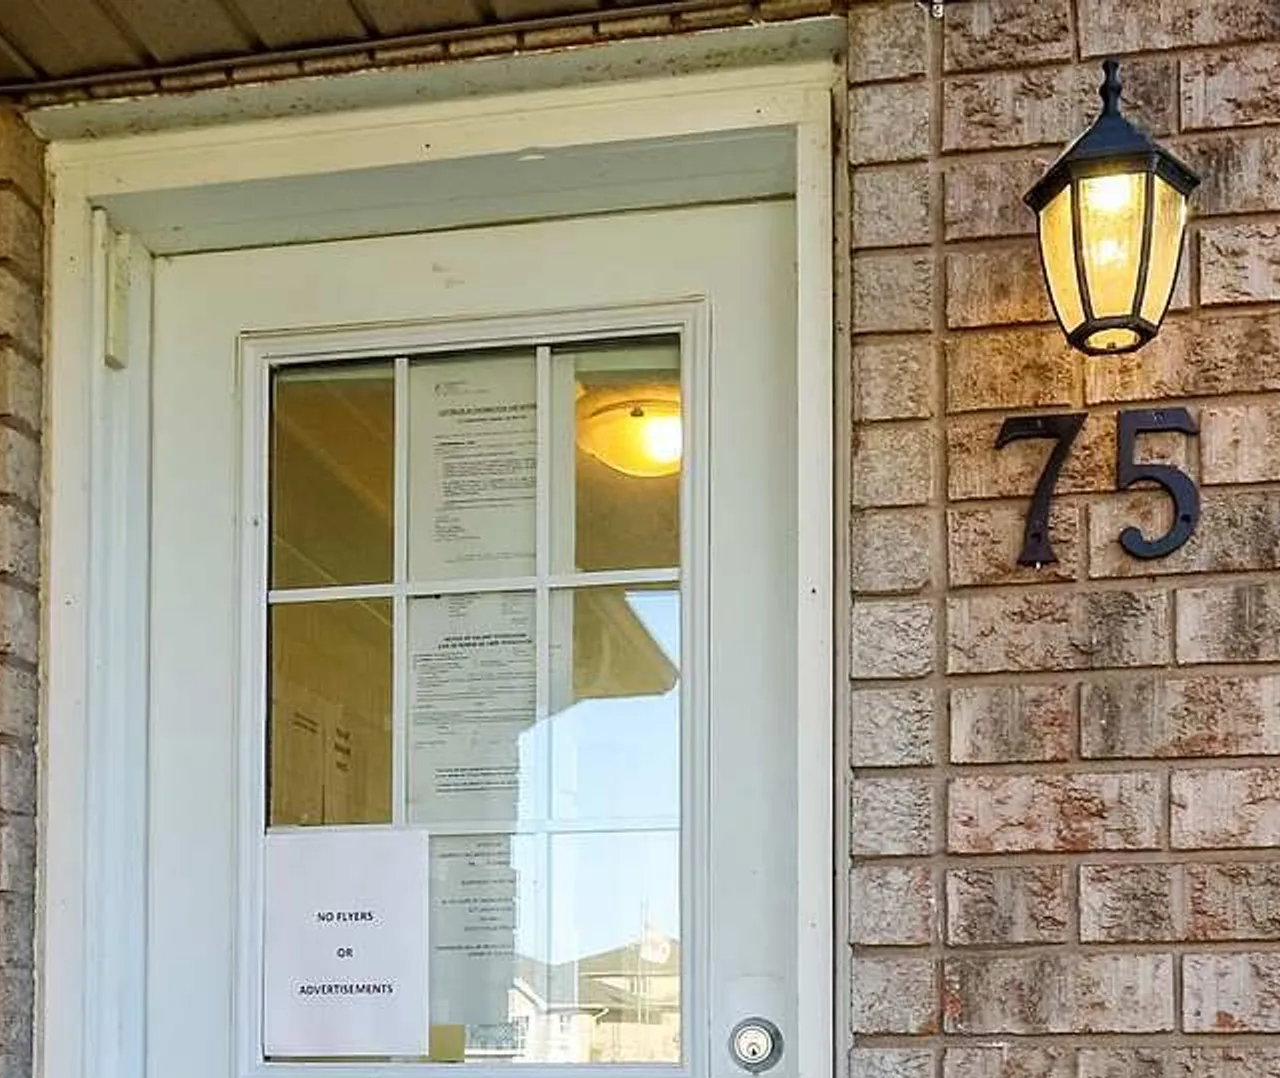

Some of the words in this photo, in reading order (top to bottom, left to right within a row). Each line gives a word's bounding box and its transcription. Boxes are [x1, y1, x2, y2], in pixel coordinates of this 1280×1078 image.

[994, 407, 1201, 568] 75
[317, 911, 334, 922] NO
[336, 911, 373, 922] FLYERS
[336, 947, 353, 958] OR
[299, 983, 394, 995] ADVERTISEMENTS
